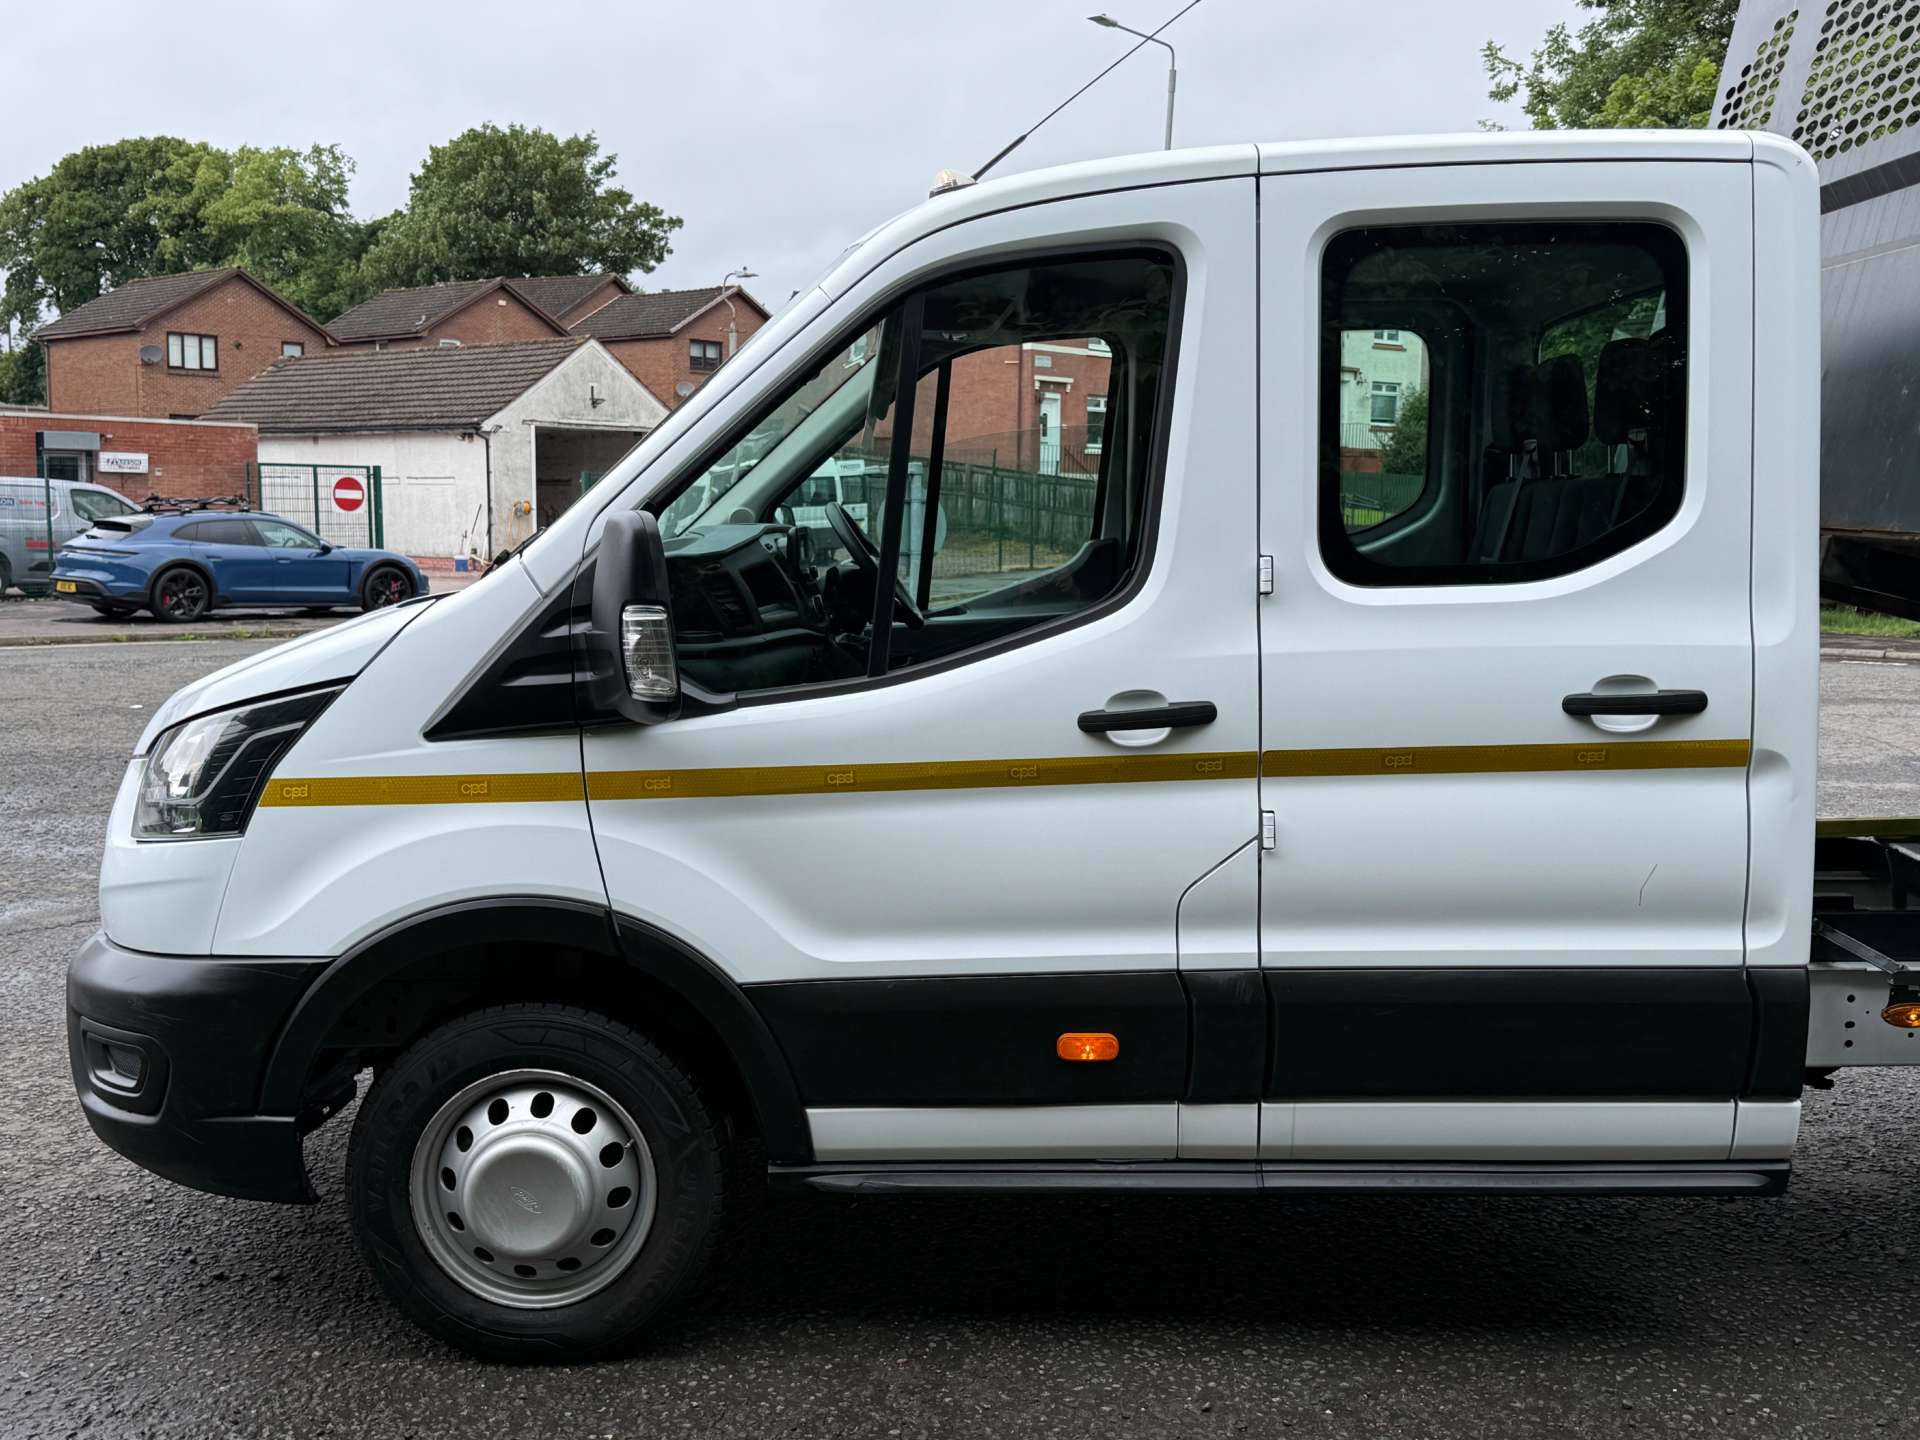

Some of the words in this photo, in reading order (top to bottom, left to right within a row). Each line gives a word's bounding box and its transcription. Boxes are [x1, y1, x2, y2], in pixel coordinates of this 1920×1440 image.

[644, 776, 671, 791] cpd
[827, 771, 854, 786] cpd
[283, 785, 308, 800] cpd
[461, 781, 487, 796] cpd
